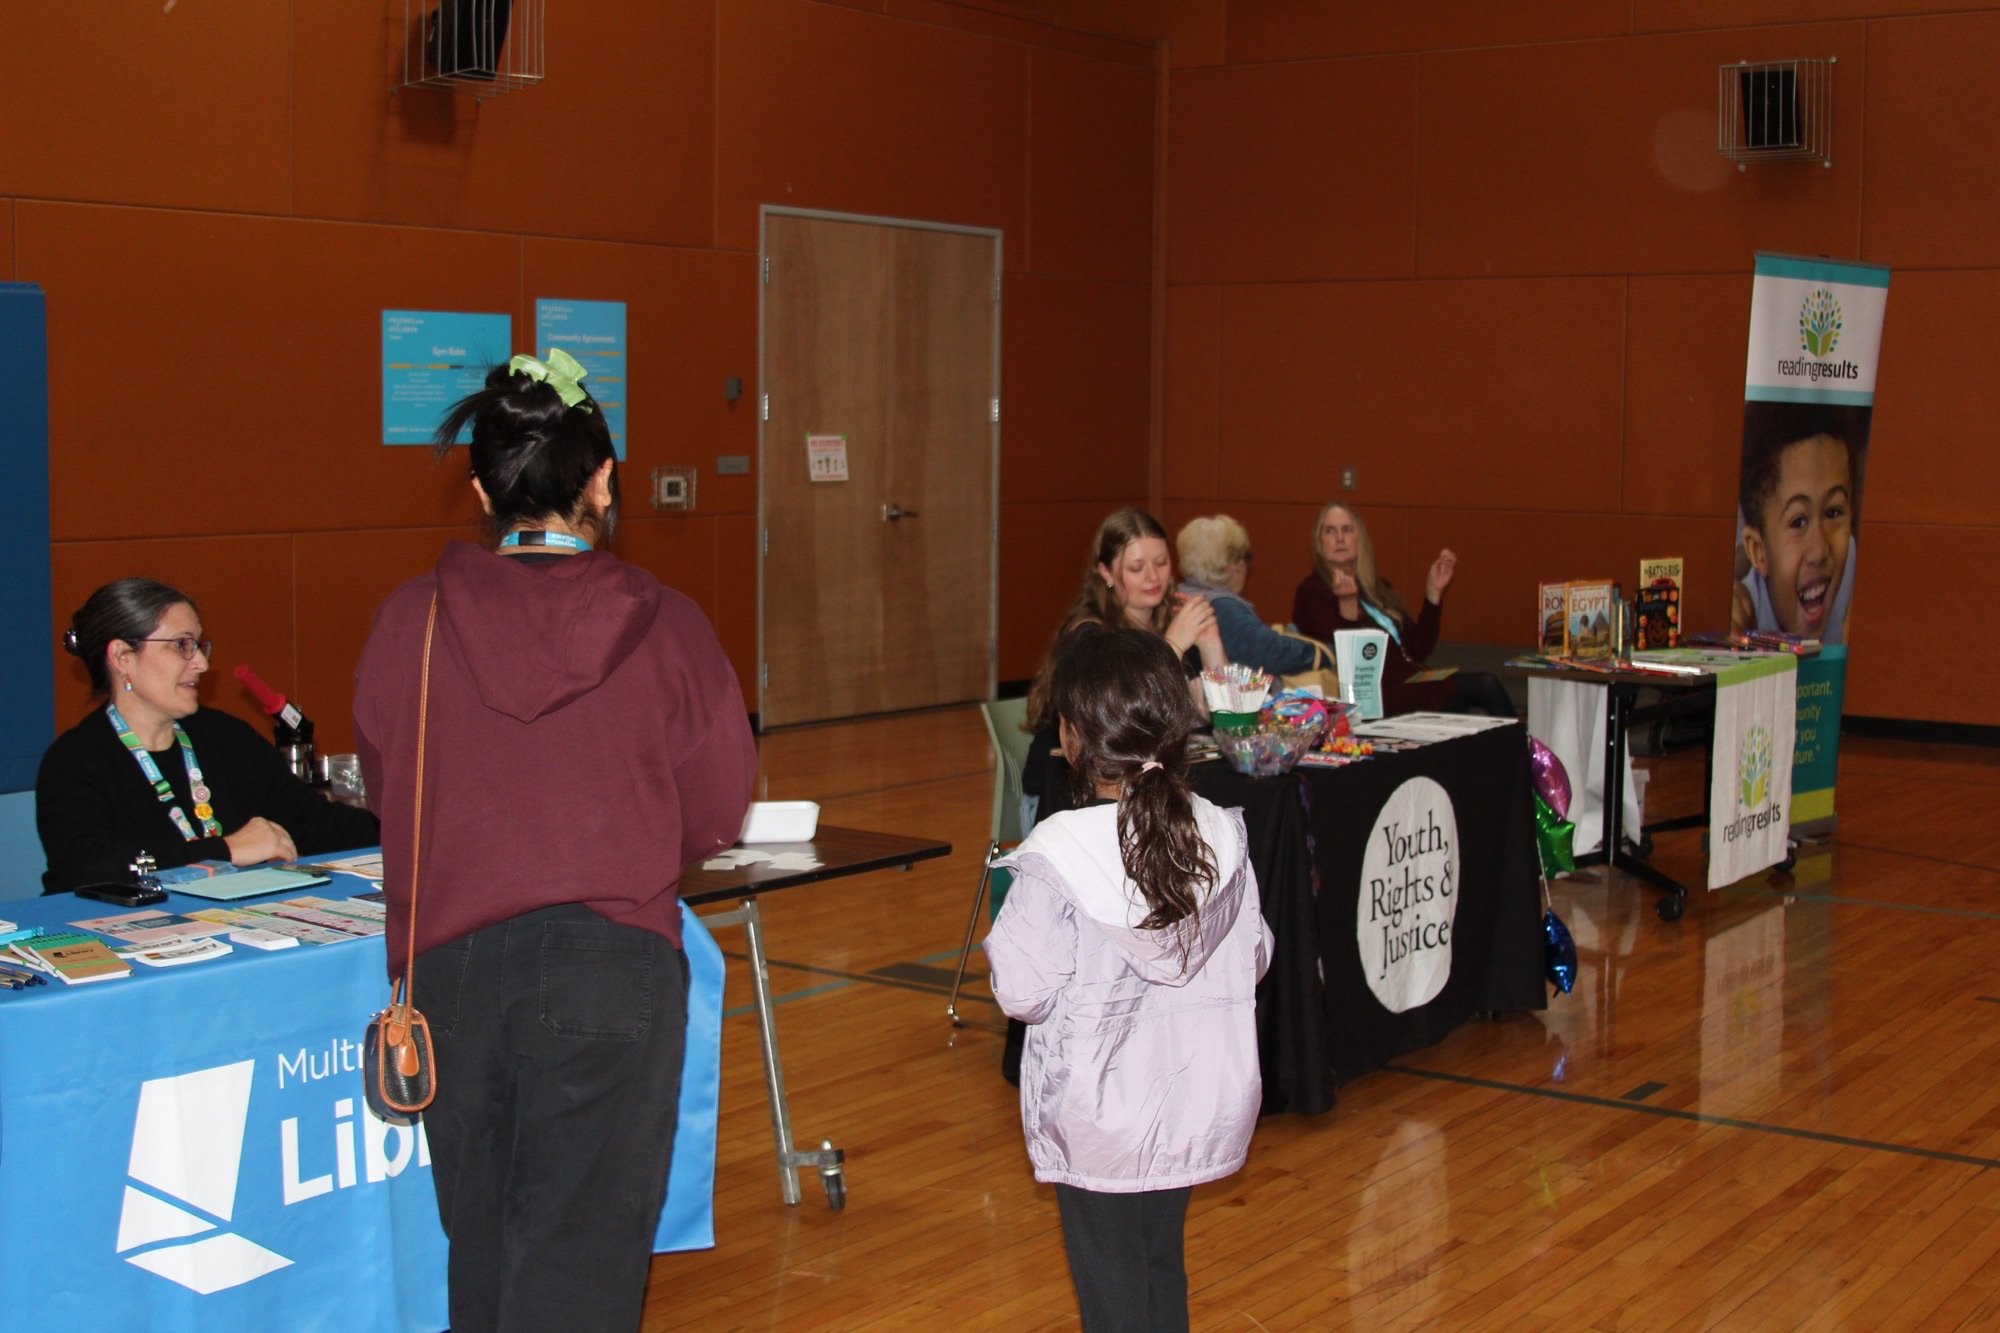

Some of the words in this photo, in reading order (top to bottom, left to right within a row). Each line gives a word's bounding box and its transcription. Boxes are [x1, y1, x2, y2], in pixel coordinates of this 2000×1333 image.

[1778, 357, 1859, 382] readingresults
[1572, 596, 1607, 612] EGYPT
[1383, 809, 1449, 867] Youth,
[1370, 866, 1434, 929] Rights
[1440, 860, 1454, 898] &
[1380, 914, 1450, 980] Justice
